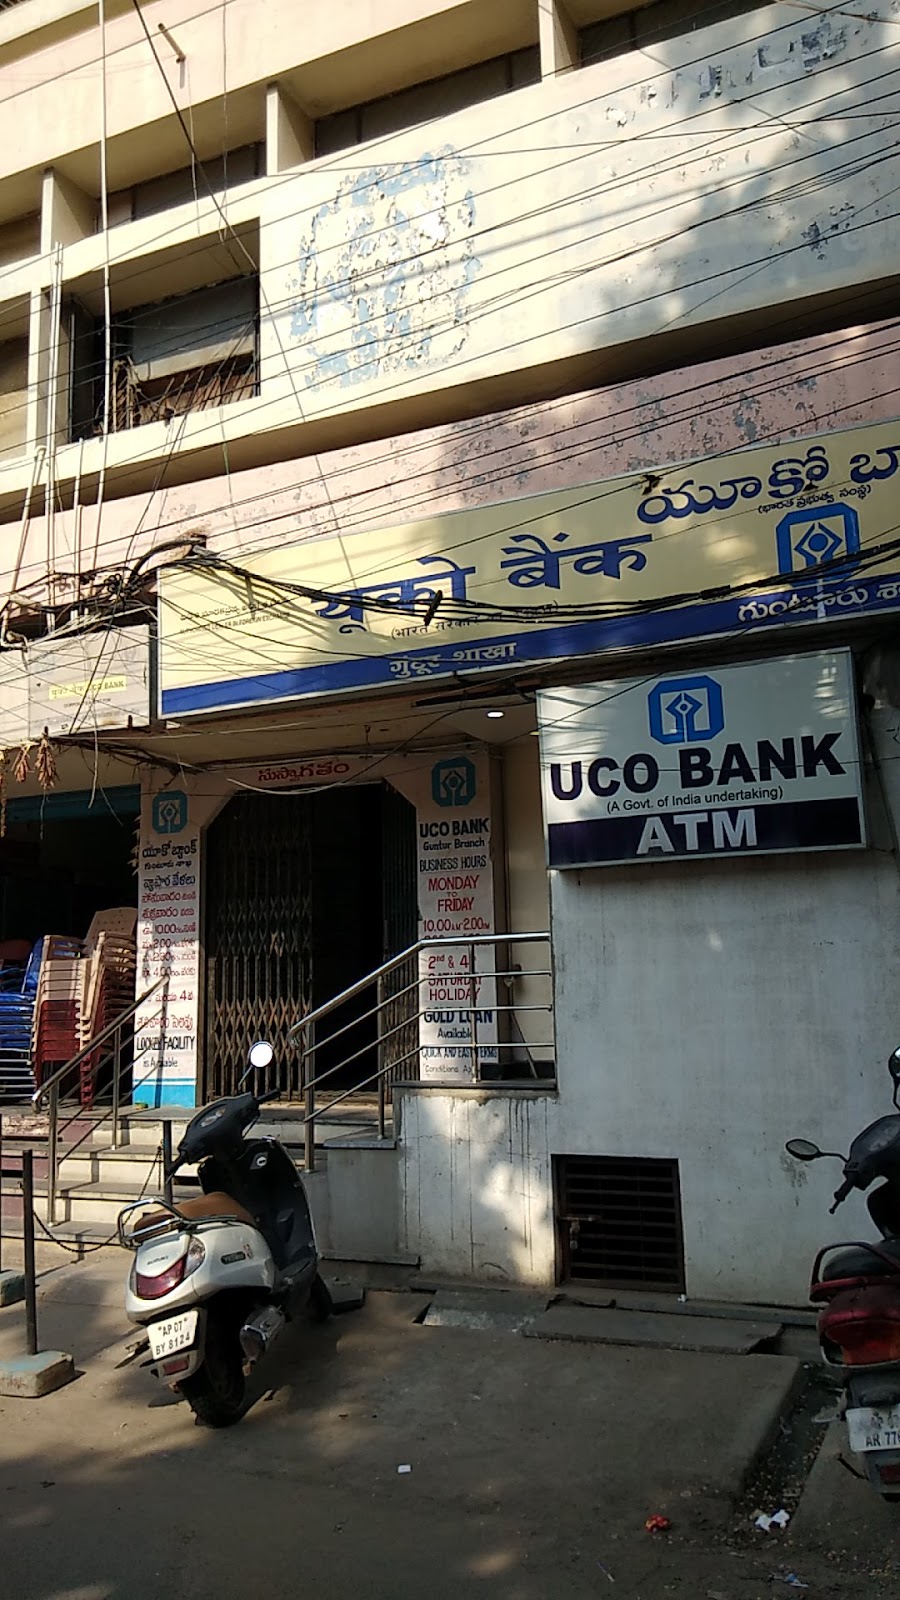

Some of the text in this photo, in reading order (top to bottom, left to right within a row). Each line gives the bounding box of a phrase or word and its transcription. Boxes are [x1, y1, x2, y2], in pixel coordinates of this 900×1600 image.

[311, 531, 653, 634] यूको बैंक
[453, 642, 517, 664] शाखा
[550, 731, 846, 800] UCO BANK
[606, 785, 783, 814] (A Govt. of India undertaking)
[420, 818, 490, 838] UCO BANK
[636, 807, 758, 855] ATM
[423, 837, 485, 851] Guntur Branch
[420, 855, 487, 872] BUSINESS HOURS
[428, 875, 480, 892] MONDAY
[437, 897, 475, 912] FRIDAY
[448, 955, 455, 969] &
[429, 987, 480, 1001] HOLIDAY
[164, 1035, 195, 1050] FACILITY
[163, 1324, 172, 1337] AP
[155, 1342, 166, 1356] BY
